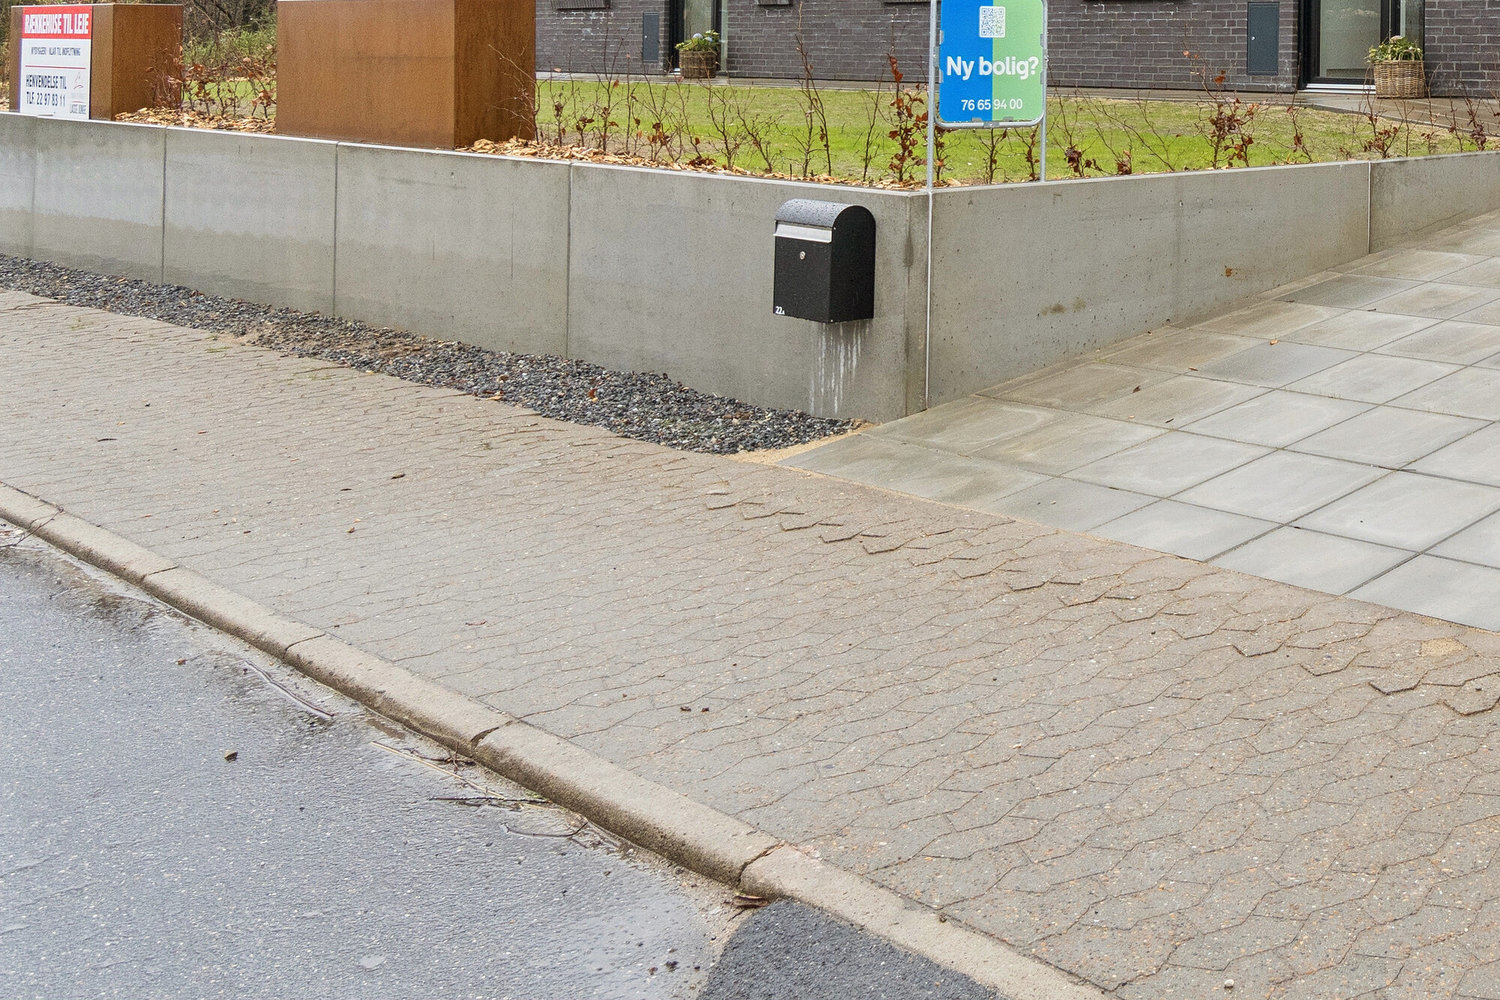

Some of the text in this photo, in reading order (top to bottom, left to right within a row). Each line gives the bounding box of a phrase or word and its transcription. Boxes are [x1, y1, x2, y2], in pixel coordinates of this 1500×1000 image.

[63, 13, 74, 34] TIL
[74, 13, 89, 35] LEJE
[946, 56, 1039, 80] Ny bolig?
[25, 74, 58, 88] HENVENDELSE
[36, 92, 43, 105] 22
[44, 92, 51, 106] 97
[52, 93, 58, 106] 83
[59, 94, 66, 107] 11
[961, 98, 1023, 111] 76 65 94 00
